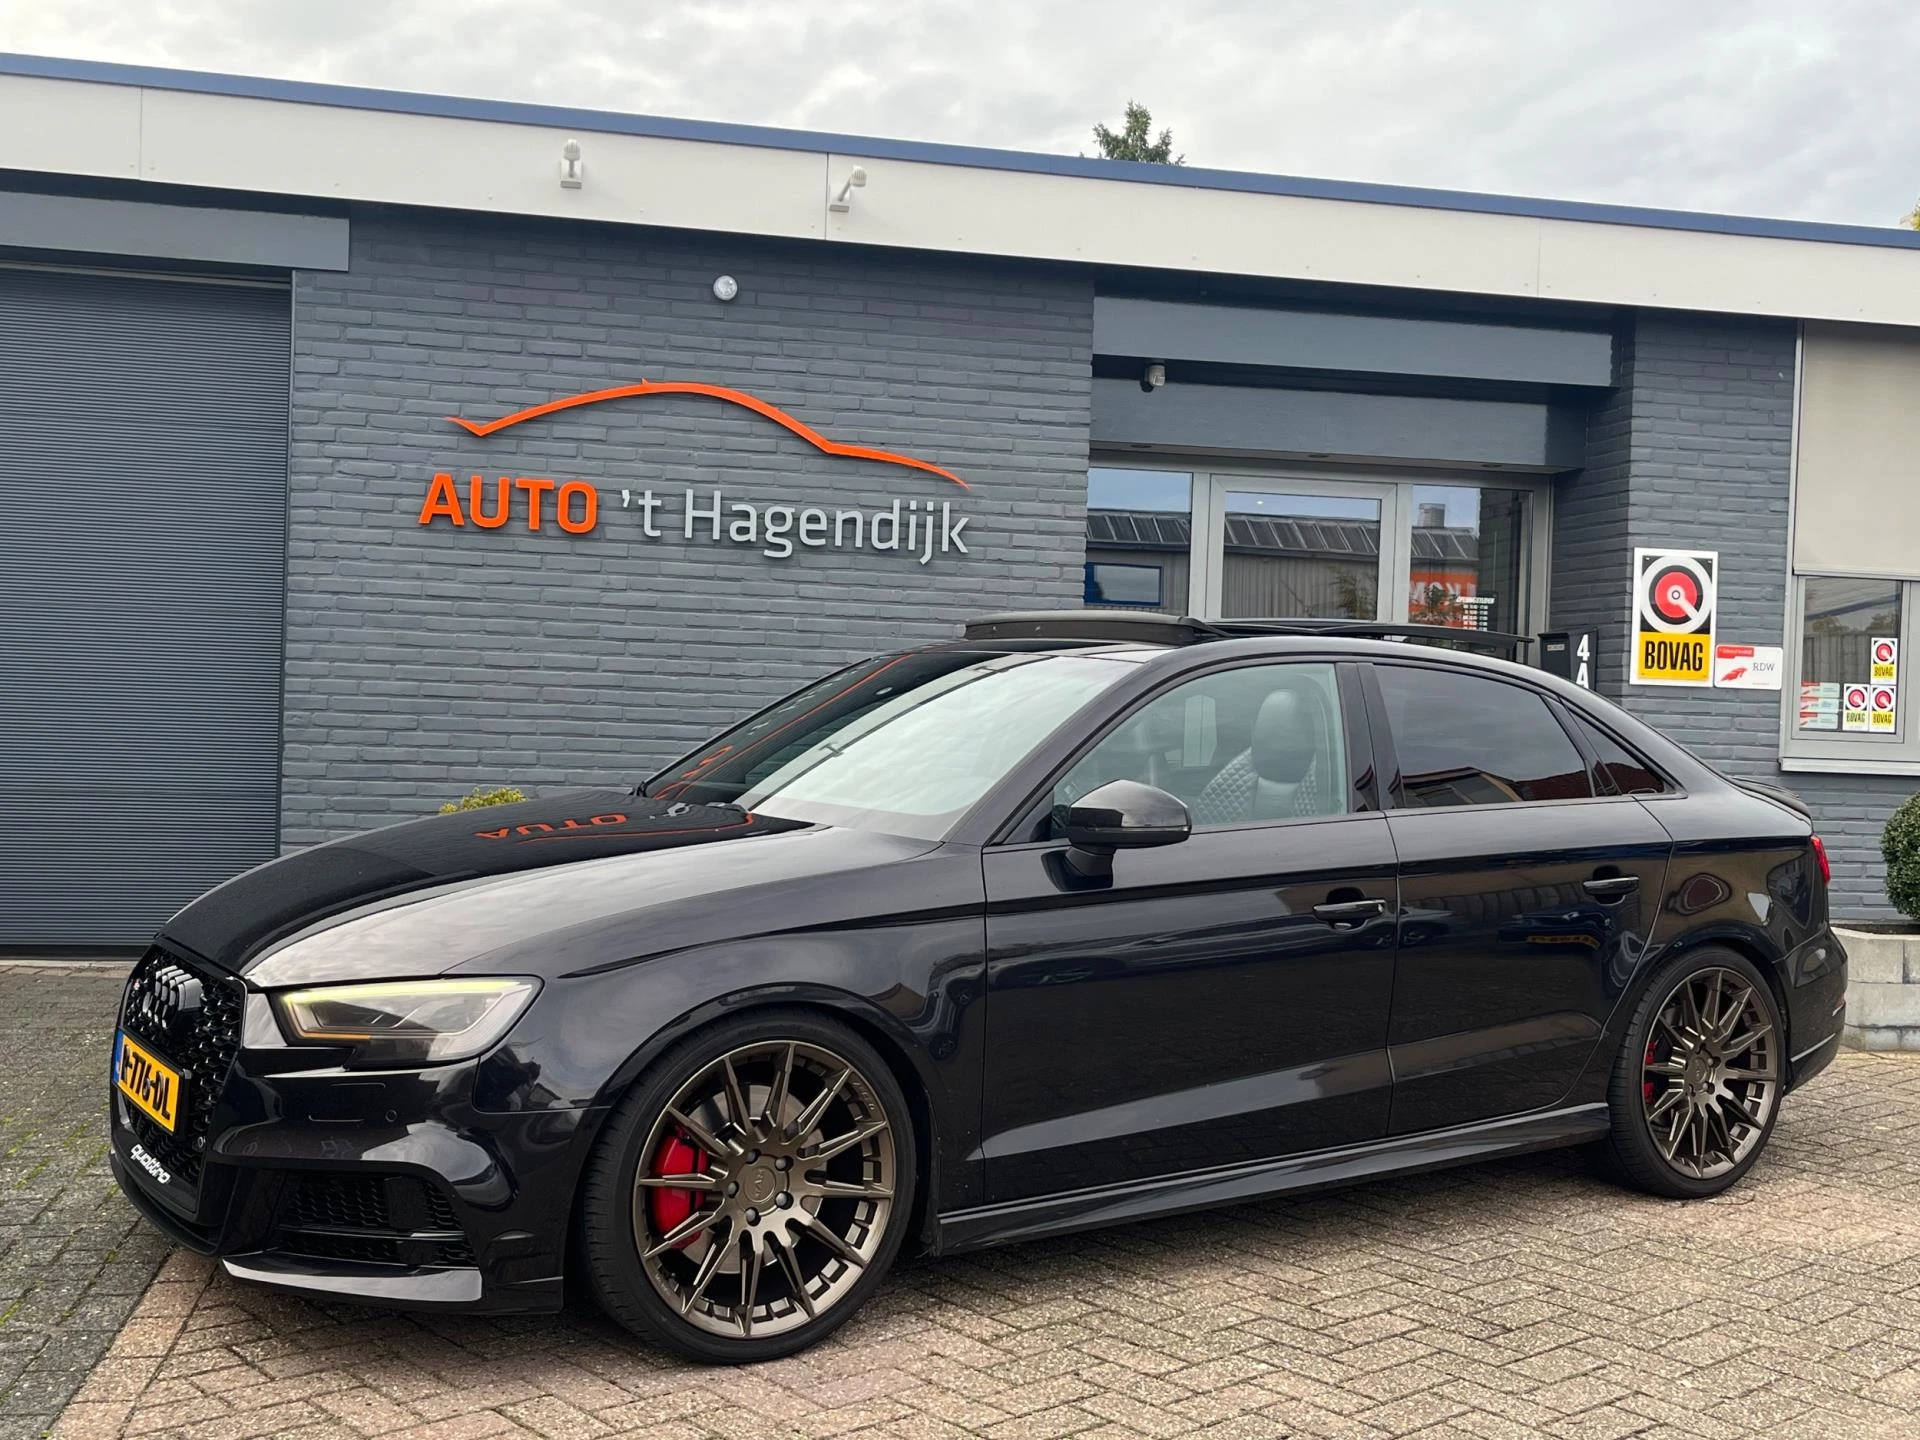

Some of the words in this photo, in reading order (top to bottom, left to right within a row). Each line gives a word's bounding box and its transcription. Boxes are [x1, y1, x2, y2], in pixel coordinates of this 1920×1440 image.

[418, 473, 598, 533] AUTO
[685, 489, 969, 565] Hagendijk
[1645, 640, 1703, 671] BOVAG
[1752, 662, 1776, 672] RDW
[1874, 666, 1893, 677] BOVAG
[1846, 713, 1866, 723] BOVAG
[1873, 713, 1892, 724] BOVAG
[130, 1143, 171, 1184] quattro
